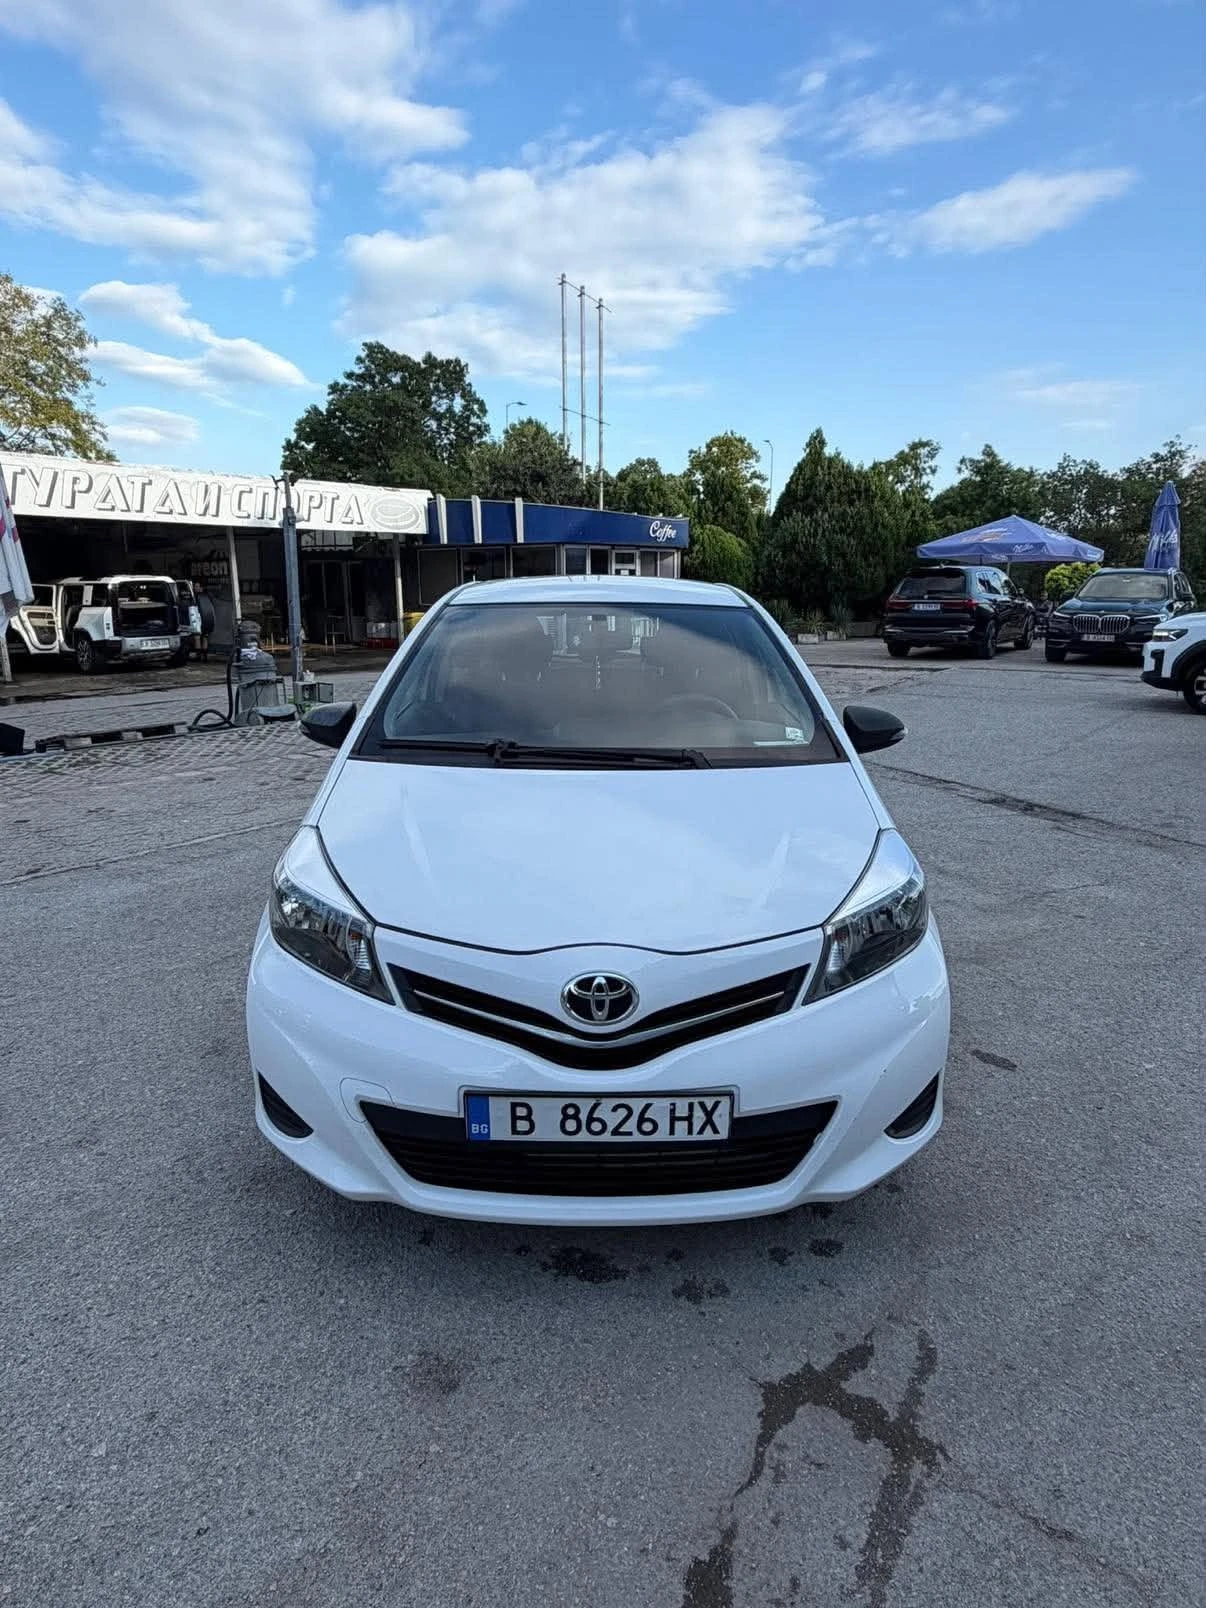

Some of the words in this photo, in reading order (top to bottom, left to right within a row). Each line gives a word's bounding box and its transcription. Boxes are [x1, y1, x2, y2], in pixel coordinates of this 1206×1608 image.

[649, 520, 677, 542] Coffee
[470, 1123, 489, 1135] BG
[509, 1101, 536, 1137] B
[558, 1101, 660, 1137] 8626
[668, 1099, 722, 1137] HX
